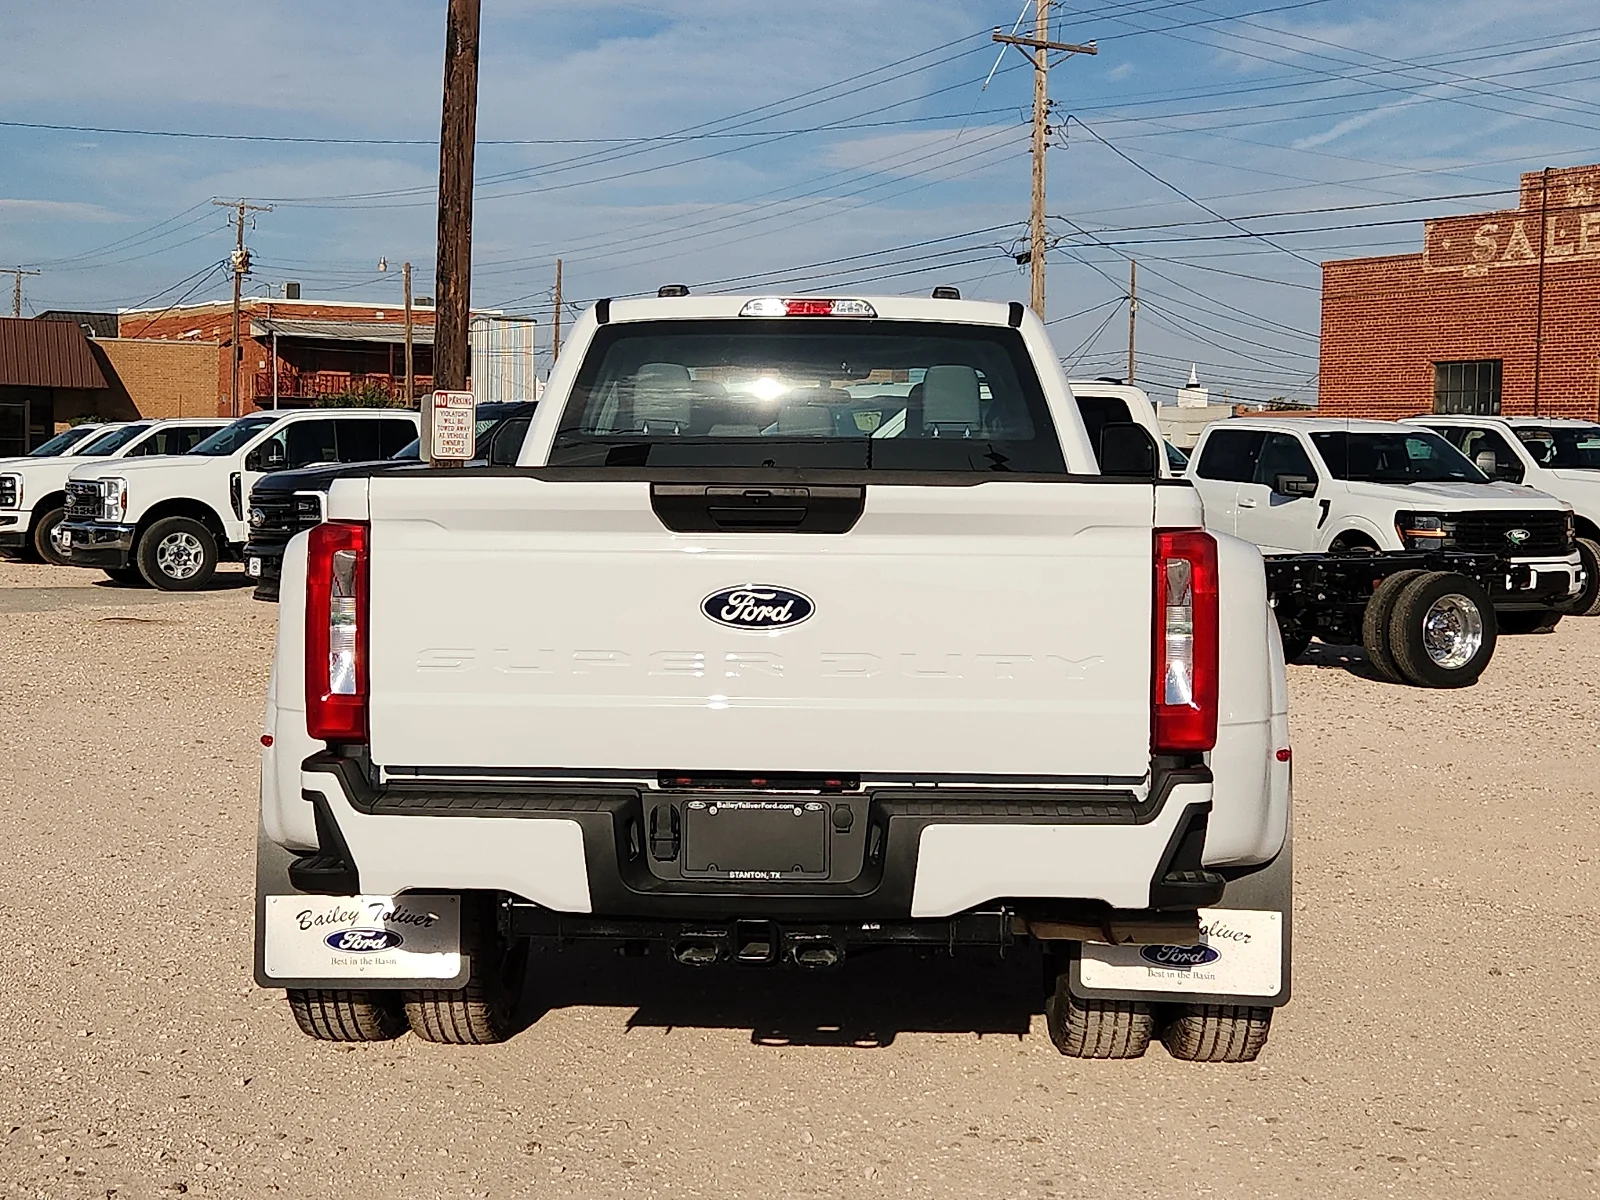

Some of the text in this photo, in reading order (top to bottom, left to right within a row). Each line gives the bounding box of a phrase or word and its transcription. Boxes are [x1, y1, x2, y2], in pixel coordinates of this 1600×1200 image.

[435, 394, 471, 406] NO PARKING
[721, 591, 794, 621] Ford
[416, 648, 1104, 679] SUPER DUTY
[729, 871, 769, 880] STANTON,
[296, 902, 434, 931] Bailey Toliver
[1197, 916, 1252, 944] oliver
[339, 931, 387, 949] Ford
[331, 957, 347, 965] Best
[349, 957, 358, 965] in
[360, 957, 373, 965] the
[1157, 944, 1205, 963] Ford
[1148, 968, 1165, 977] Best
[1177, 970, 1191, 979] the
[1193, 971, 1216, 980] Basin
